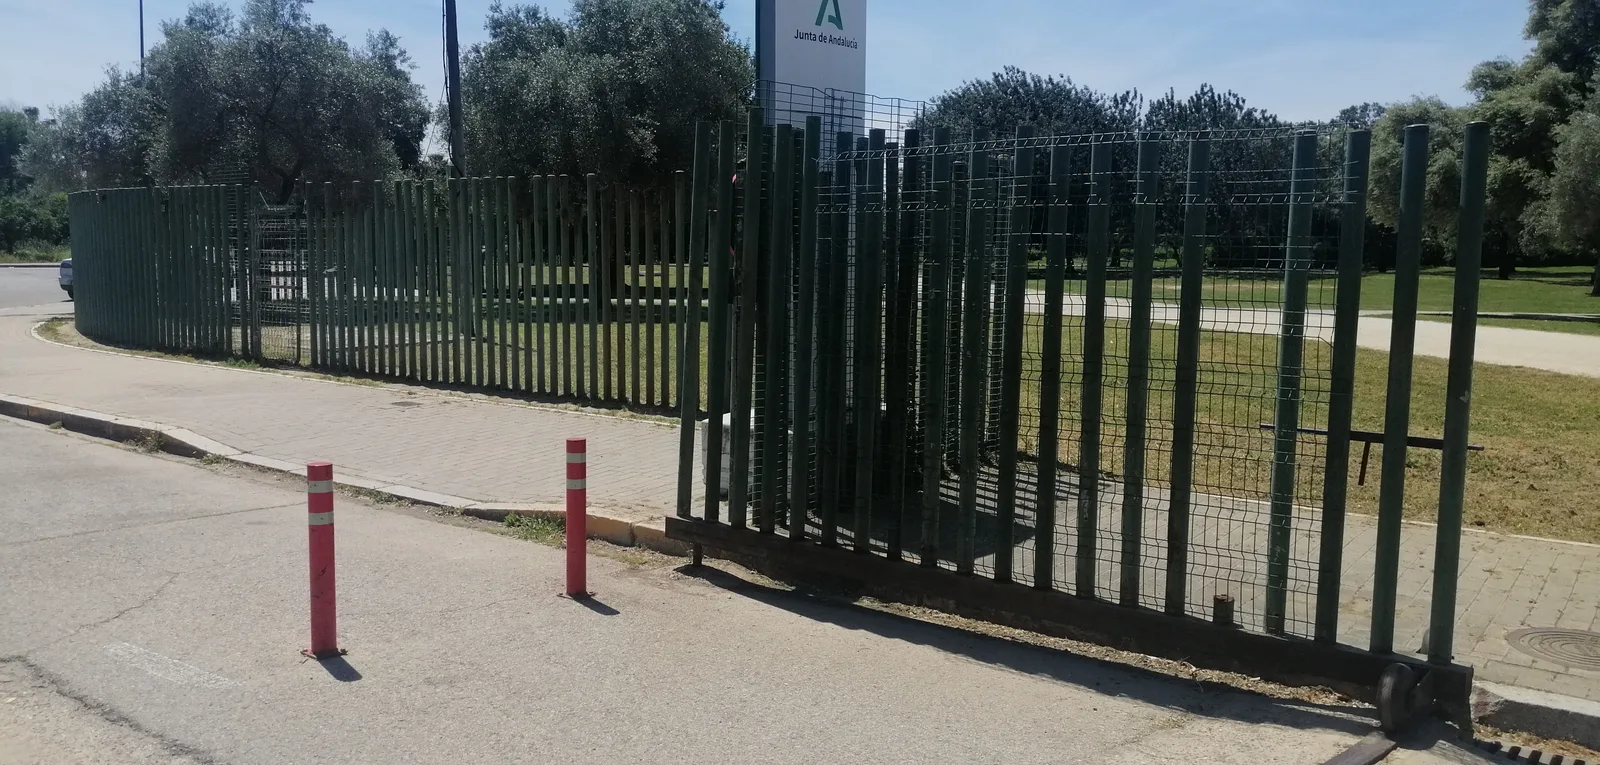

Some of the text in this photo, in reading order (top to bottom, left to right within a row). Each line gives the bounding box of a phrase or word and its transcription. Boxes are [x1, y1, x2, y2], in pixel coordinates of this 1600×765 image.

[794, 29, 858, 49] Junta de Andalucía
